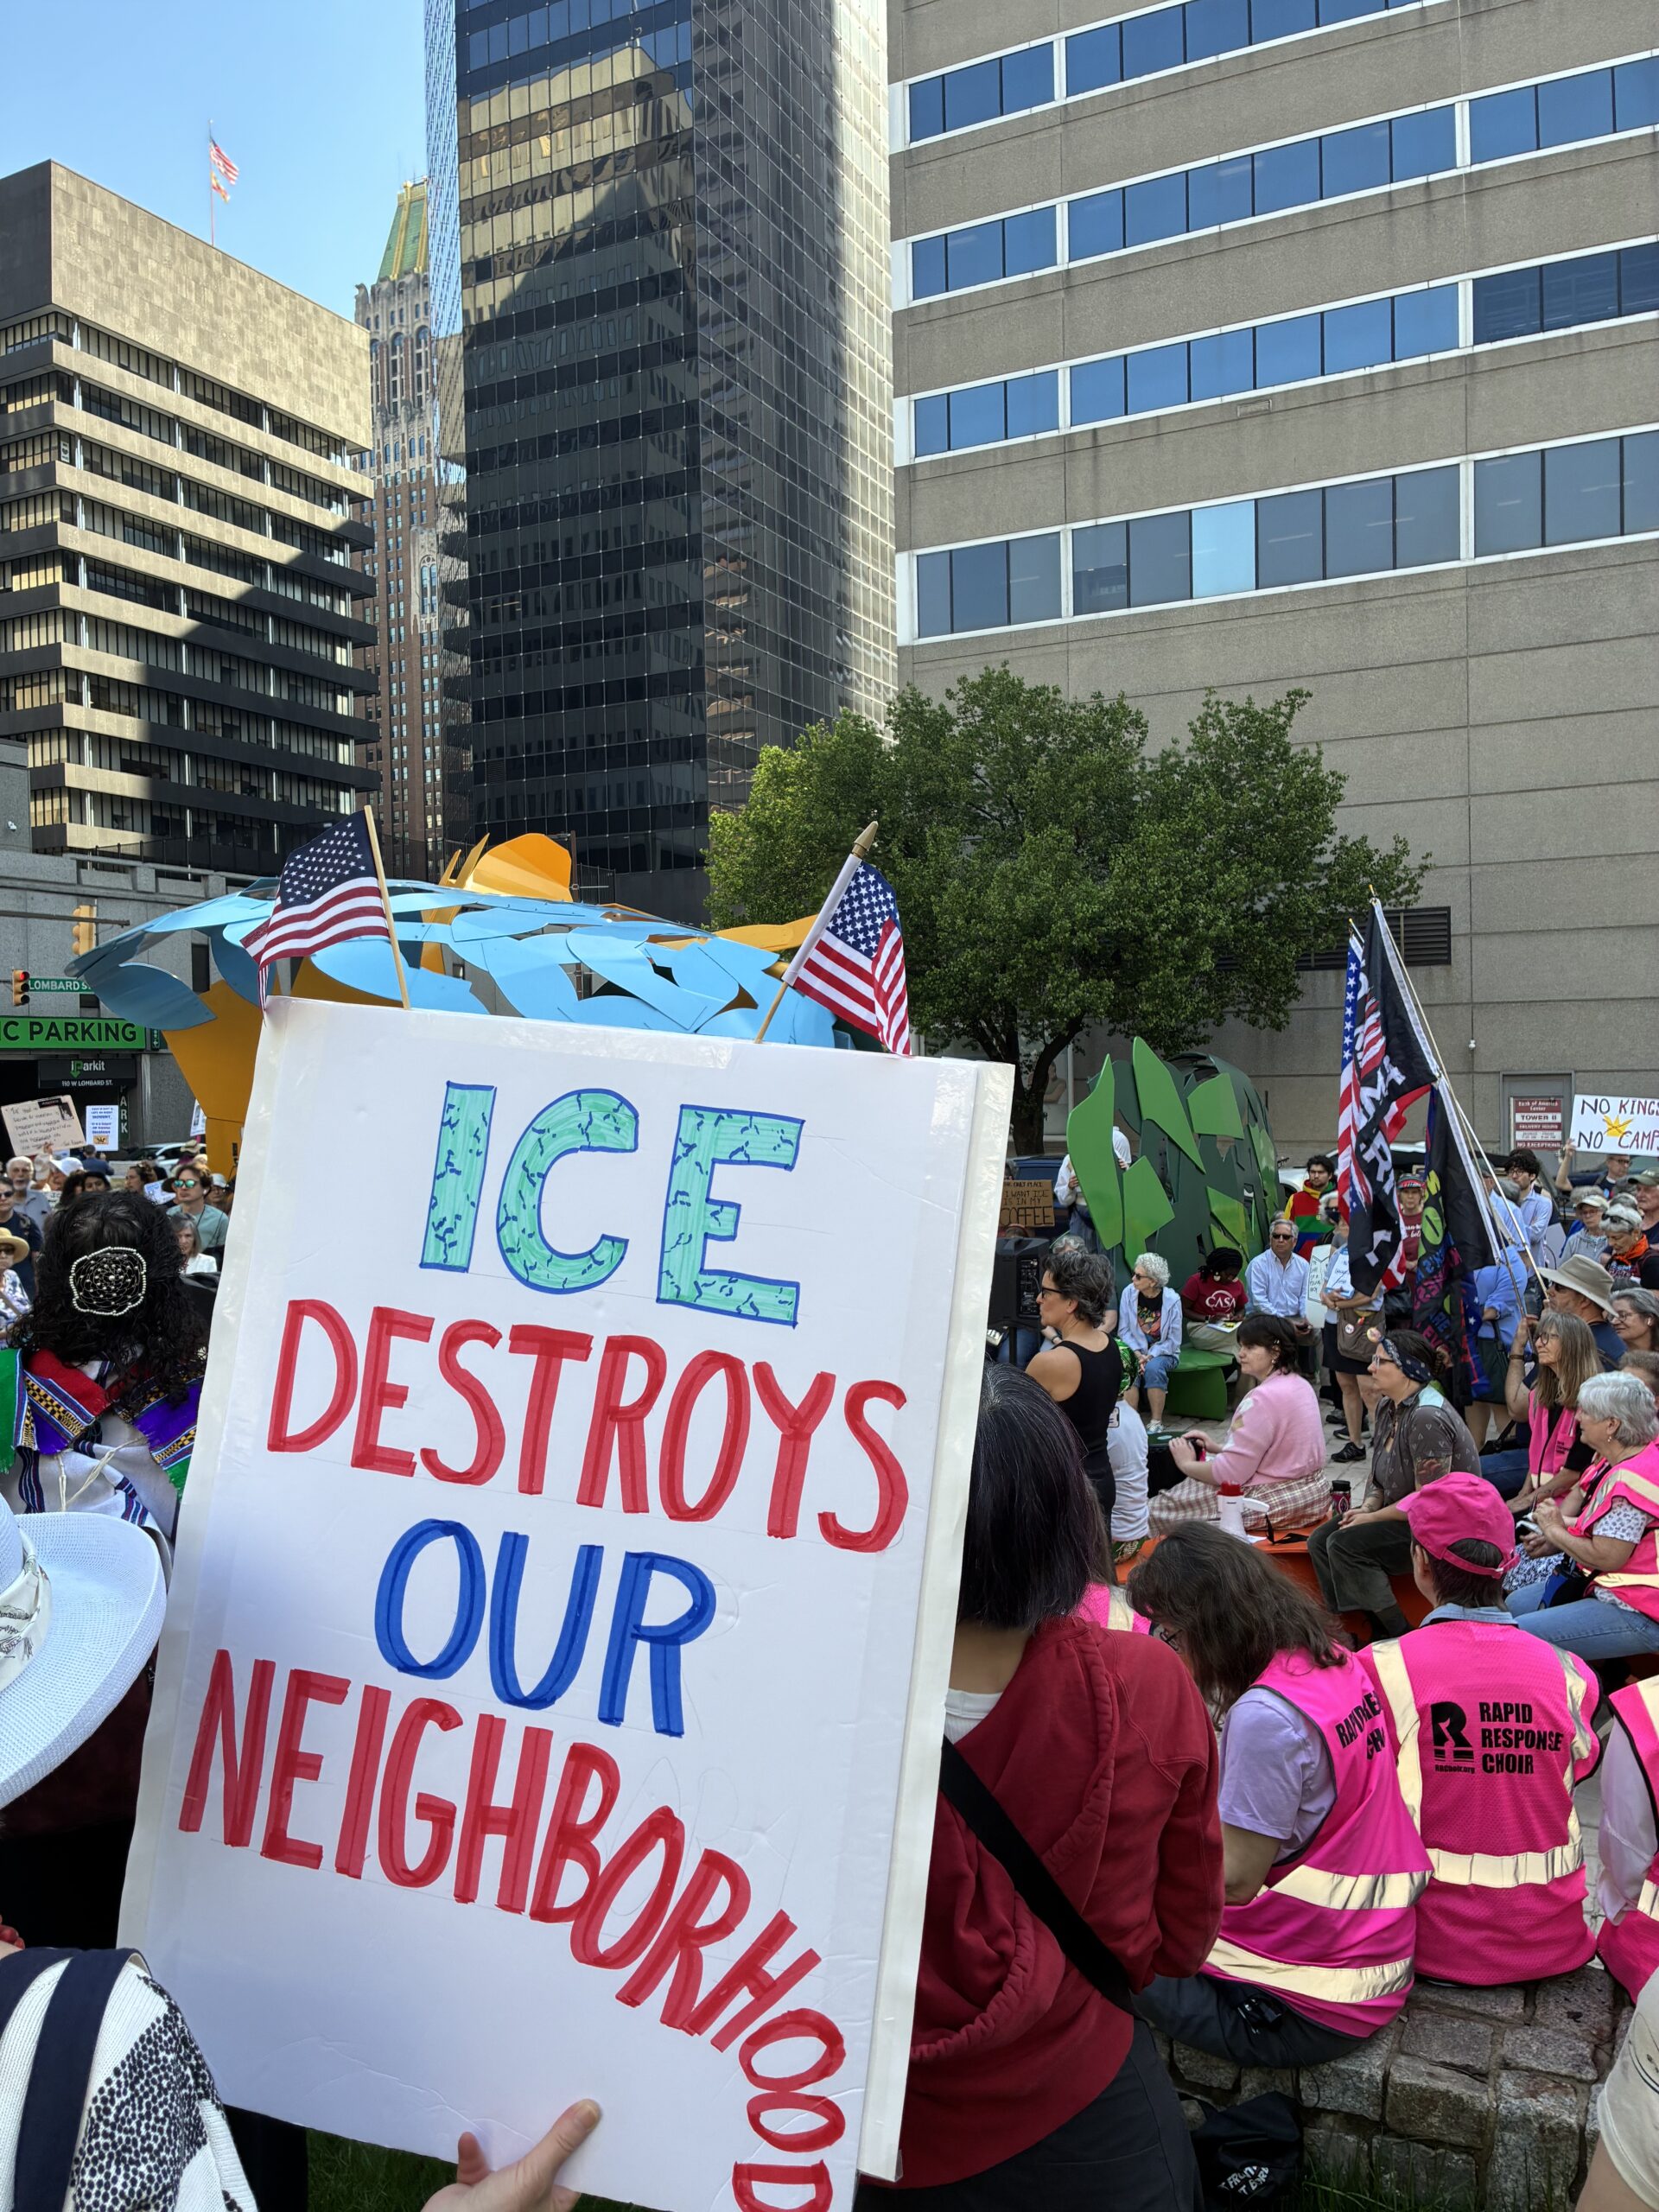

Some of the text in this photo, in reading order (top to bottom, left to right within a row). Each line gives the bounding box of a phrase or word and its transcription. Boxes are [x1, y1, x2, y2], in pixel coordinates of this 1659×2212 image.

[29, 980, 80, 991] LOMBARD
[29, 1022, 137, 1042] PARKING
[1580, 1097, 1611, 1116] NO
[1577, 1129, 1659, 1151] NO CAMP
[418, 1080, 805, 1329] ICE
[999, 1205, 1054, 1228] COFFEE
[1205, 1296, 1236, 1308] CASA
[266, 1299, 910, 1554] DESTROYS
[374, 1518, 716, 1738] OUR
[1479, 1701, 1533, 1724] RAPID
[1481, 1727, 1564, 1751] RESPONSE
[1482, 1752, 1535, 1775] CHOIR
[178, 1649, 845, 2212] NEIGHBORHOOD
